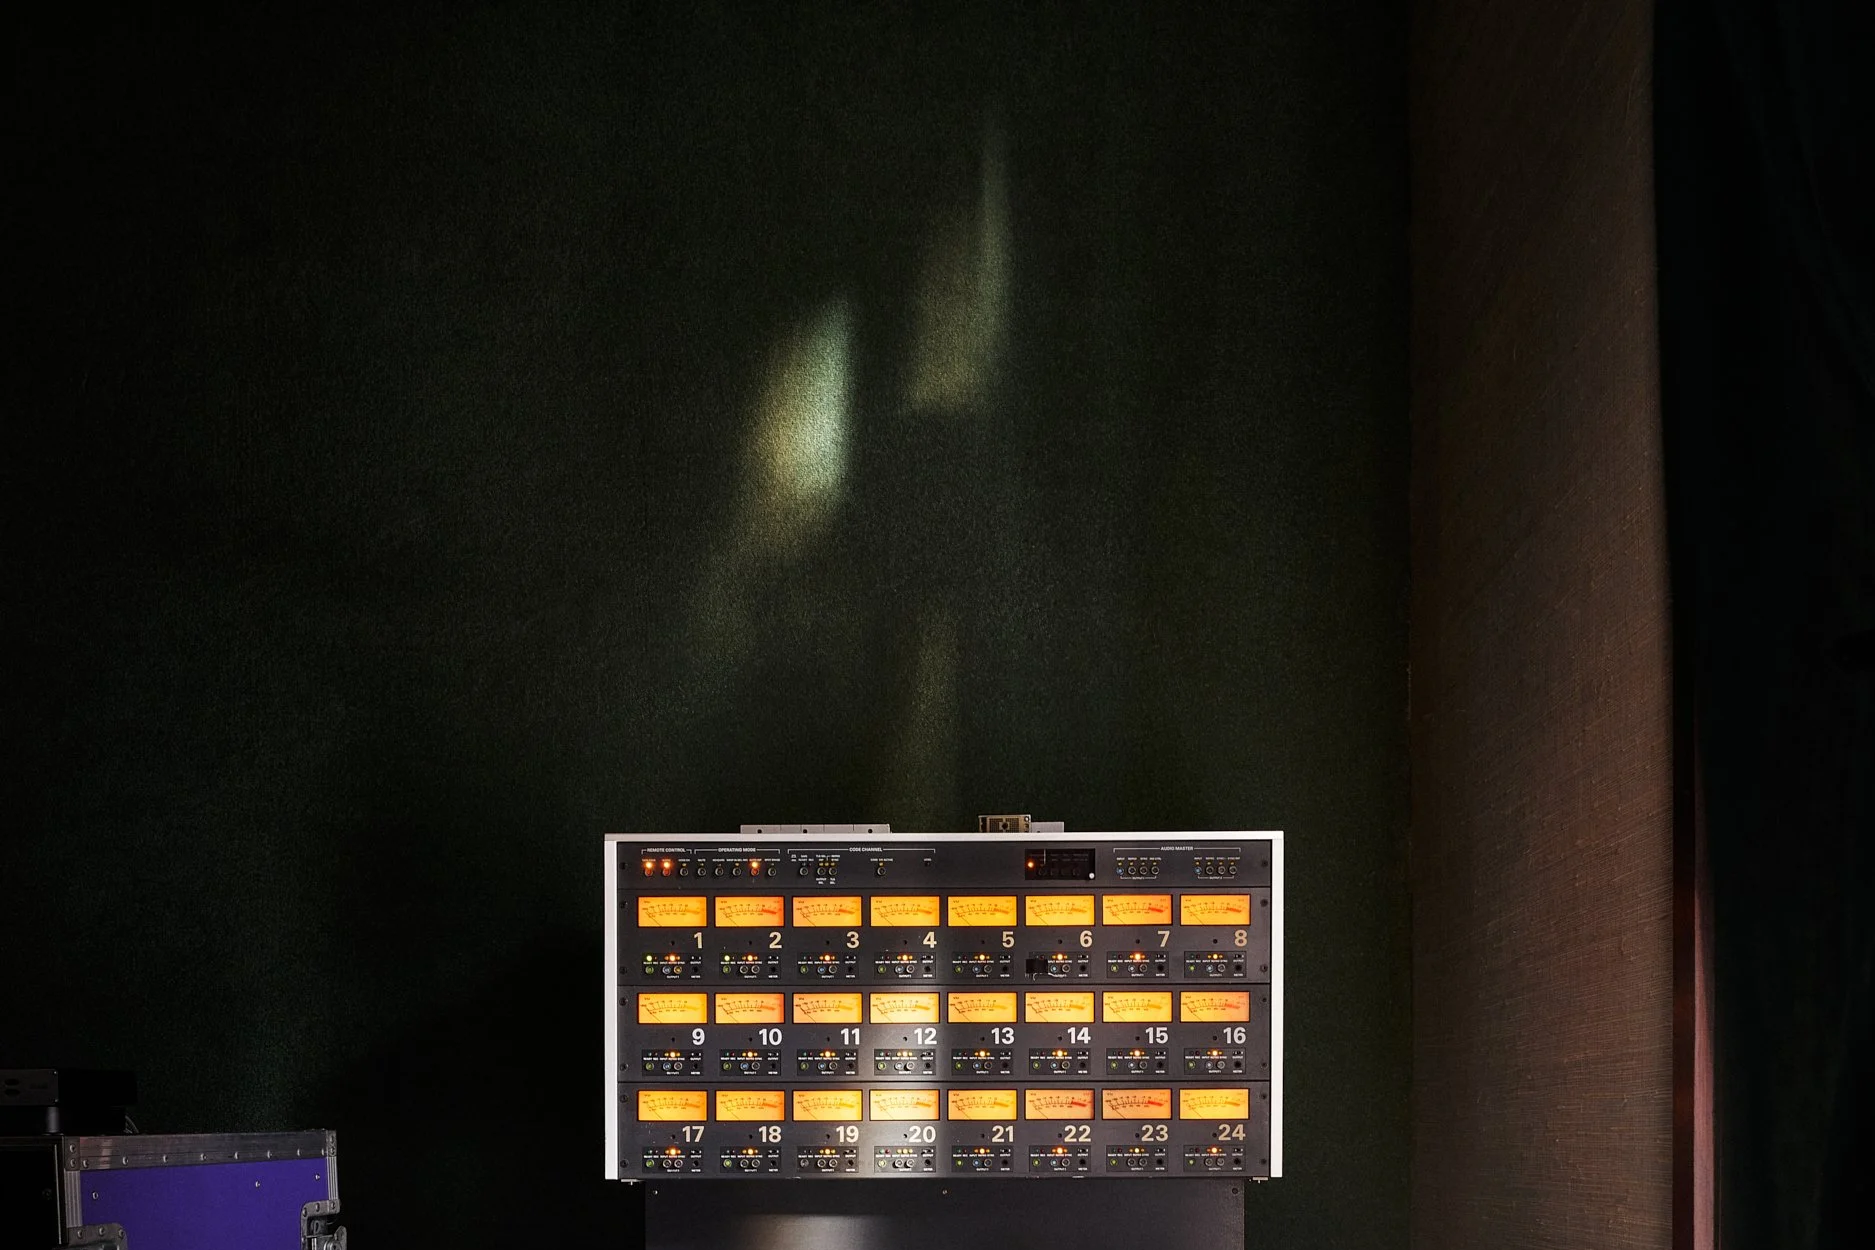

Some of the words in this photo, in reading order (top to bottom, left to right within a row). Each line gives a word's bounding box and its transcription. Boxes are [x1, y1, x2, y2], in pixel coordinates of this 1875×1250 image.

[694, 932, 702, 948] 1
[770, 932, 782, 948] 2
[847, 932, 859, 948] 3
[923, 932, 937, 948] 4
[1003, 932, 1014, 947] 5
[1080, 931, 1092, 947] 6
[1158, 931, 1169, 947] 7
[1235, 930, 1247, 946] 8
[692, 1028, 704, 1045] 9
[759, 1029, 782, 1045] 10
[841, 1028, 859, 1044] 11
[914, 1028, 937, 1044] 12
[992, 1027, 1014, 1044] 13
[1068, 1027, 1091, 1043] 14
[1146, 1027, 1168, 1043] 15
[1224, 1027, 1246, 1044] 16
[683, 1126, 704, 1142] 17
[759, 1126, 781, 1142] 18
[836, 1126, 859, 1142] 19
[908, 1126, 935, 1143] 20
[992, 1126, 1013, 1142] 21
[1065, 1125, 1091, 1142] 22
[1142, 1125, 1168, 1141] 23
[1219, 1124, 1245, 1140] 24
